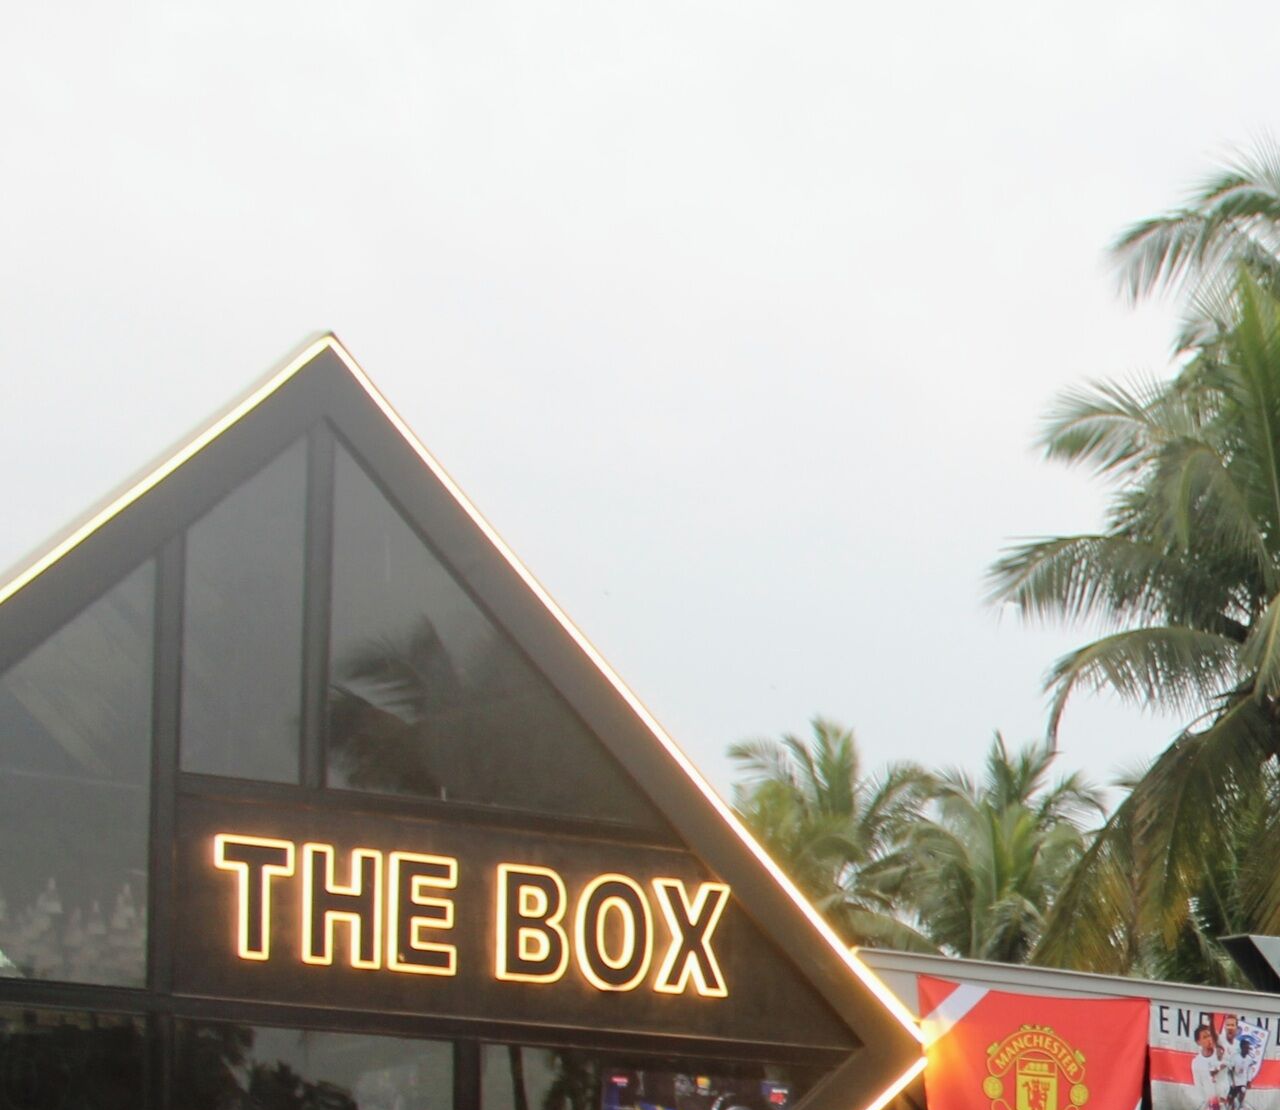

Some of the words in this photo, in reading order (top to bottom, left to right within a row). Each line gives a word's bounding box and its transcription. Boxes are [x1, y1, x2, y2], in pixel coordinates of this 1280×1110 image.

[213, 832, 459, 977] THE
[494, 862, 732, 999] BOX
[994, 1033, 1079, 1077] MANCHESTER
